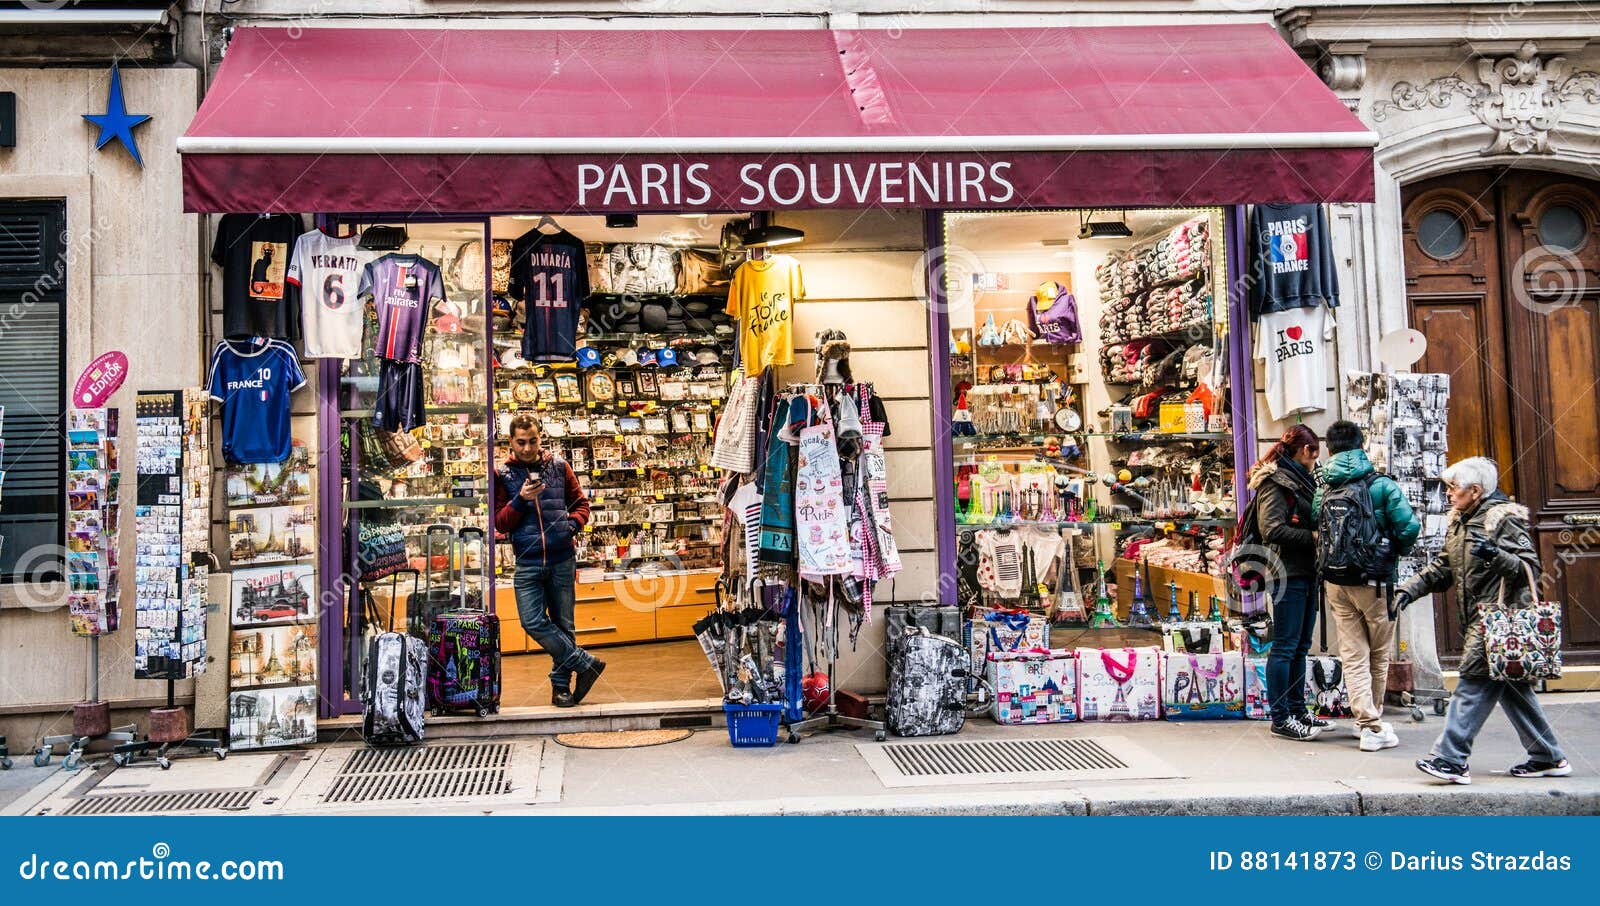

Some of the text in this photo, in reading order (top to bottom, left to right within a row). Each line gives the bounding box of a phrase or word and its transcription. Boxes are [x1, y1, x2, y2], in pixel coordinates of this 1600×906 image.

[1509, 92, 1537, 110] 124
[578, 161, 1015, 206] PARIS SOUVENIRS
[1267, 219, 1306, 236] PARIS
[311, 254, 358, 271] VERRATTI
[1272, 259, 1309, 275] FRANCE
[323, 274, 345, 309] 6
[533, 272, 568, 308] 11
[1277, 330, 1287, 346] I
[1275, 340, 1314, 363] PARIS
[88, 362, 122, 396] EDITOR
[257, 367, 271, 380] 10
[227, 378, 263, 391] FRANCE
[458, 620, 480, 630] PARIS
[1174, 669, 1236, 703] PARIS
